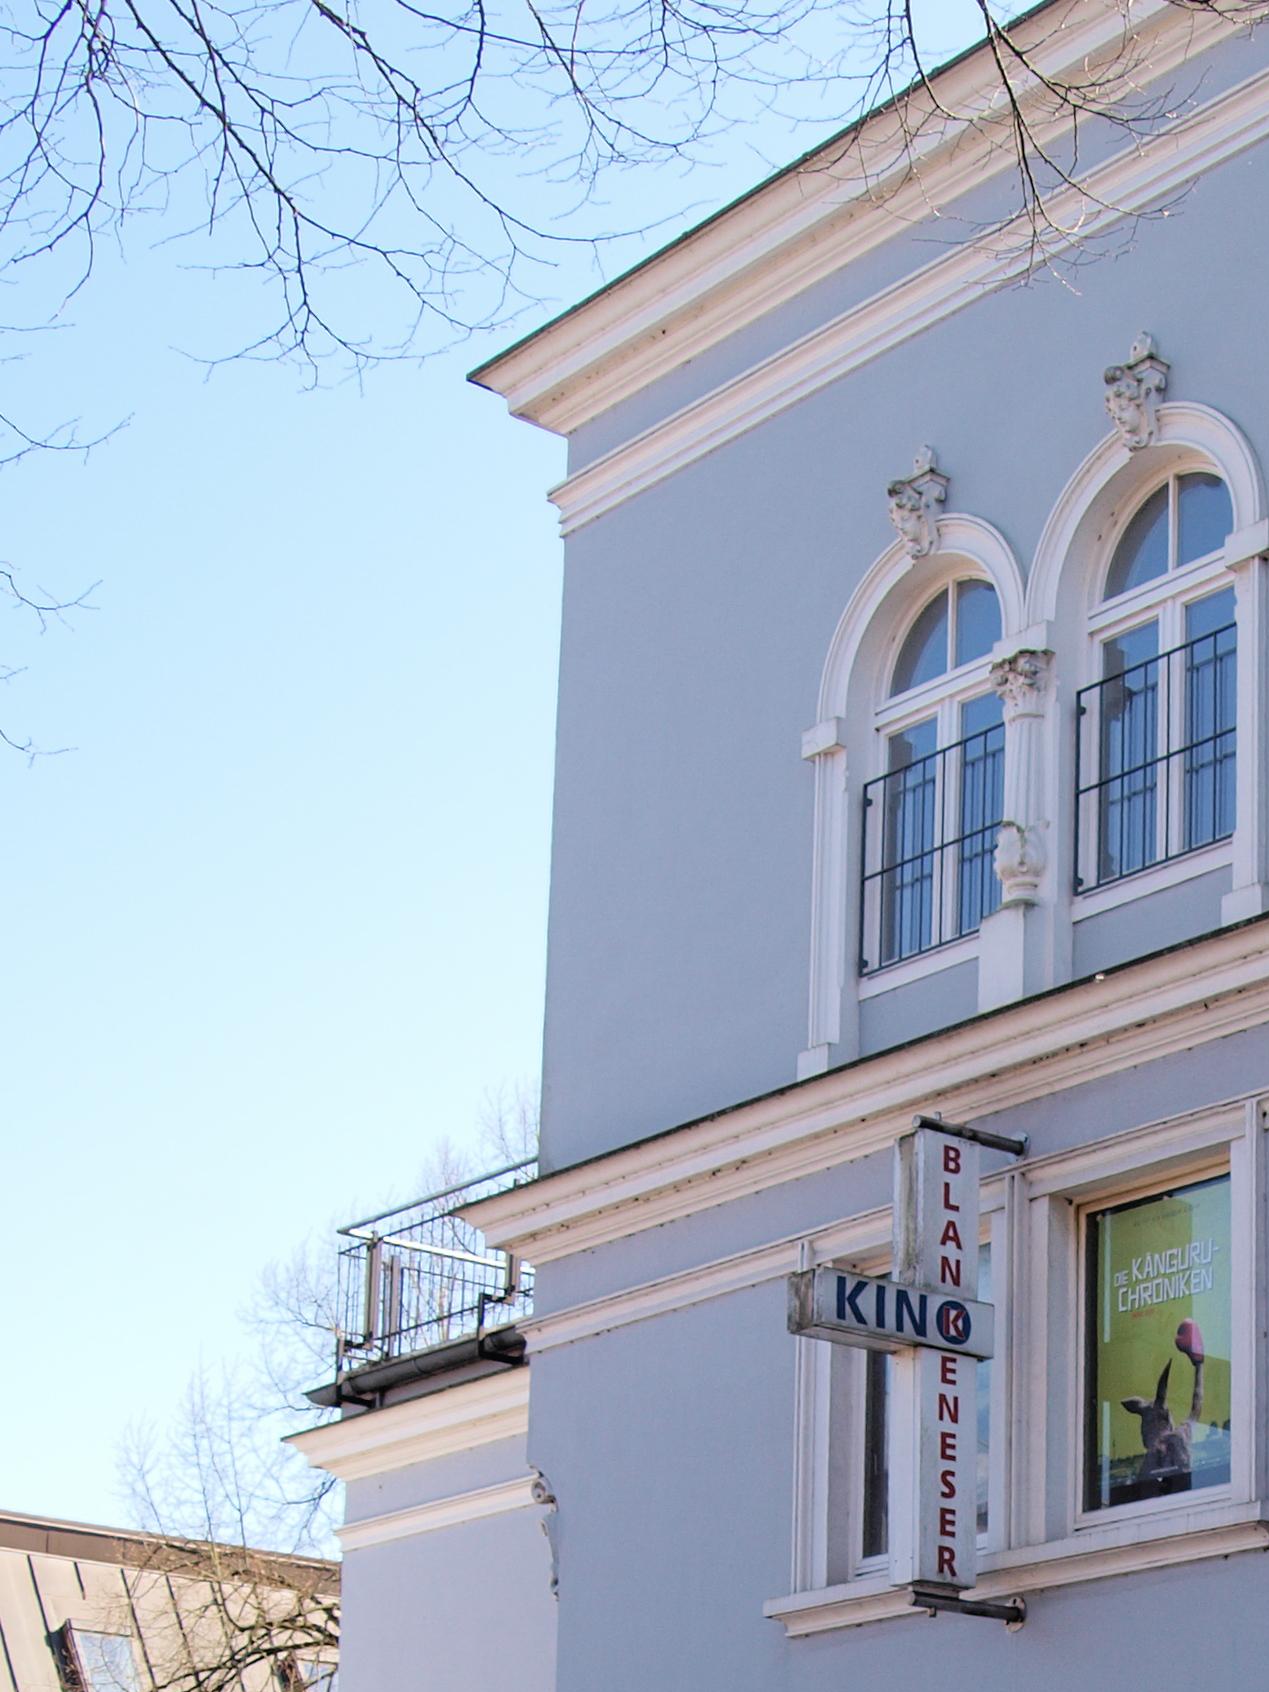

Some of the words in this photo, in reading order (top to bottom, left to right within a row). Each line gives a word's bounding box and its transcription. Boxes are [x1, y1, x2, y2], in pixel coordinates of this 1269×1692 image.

[836, 1275, 972, 1345] KINO
[1118, 1267, 1213, 1312] CHRONIKEN
[938, 1144, 965, 1577] BLANKENESER
